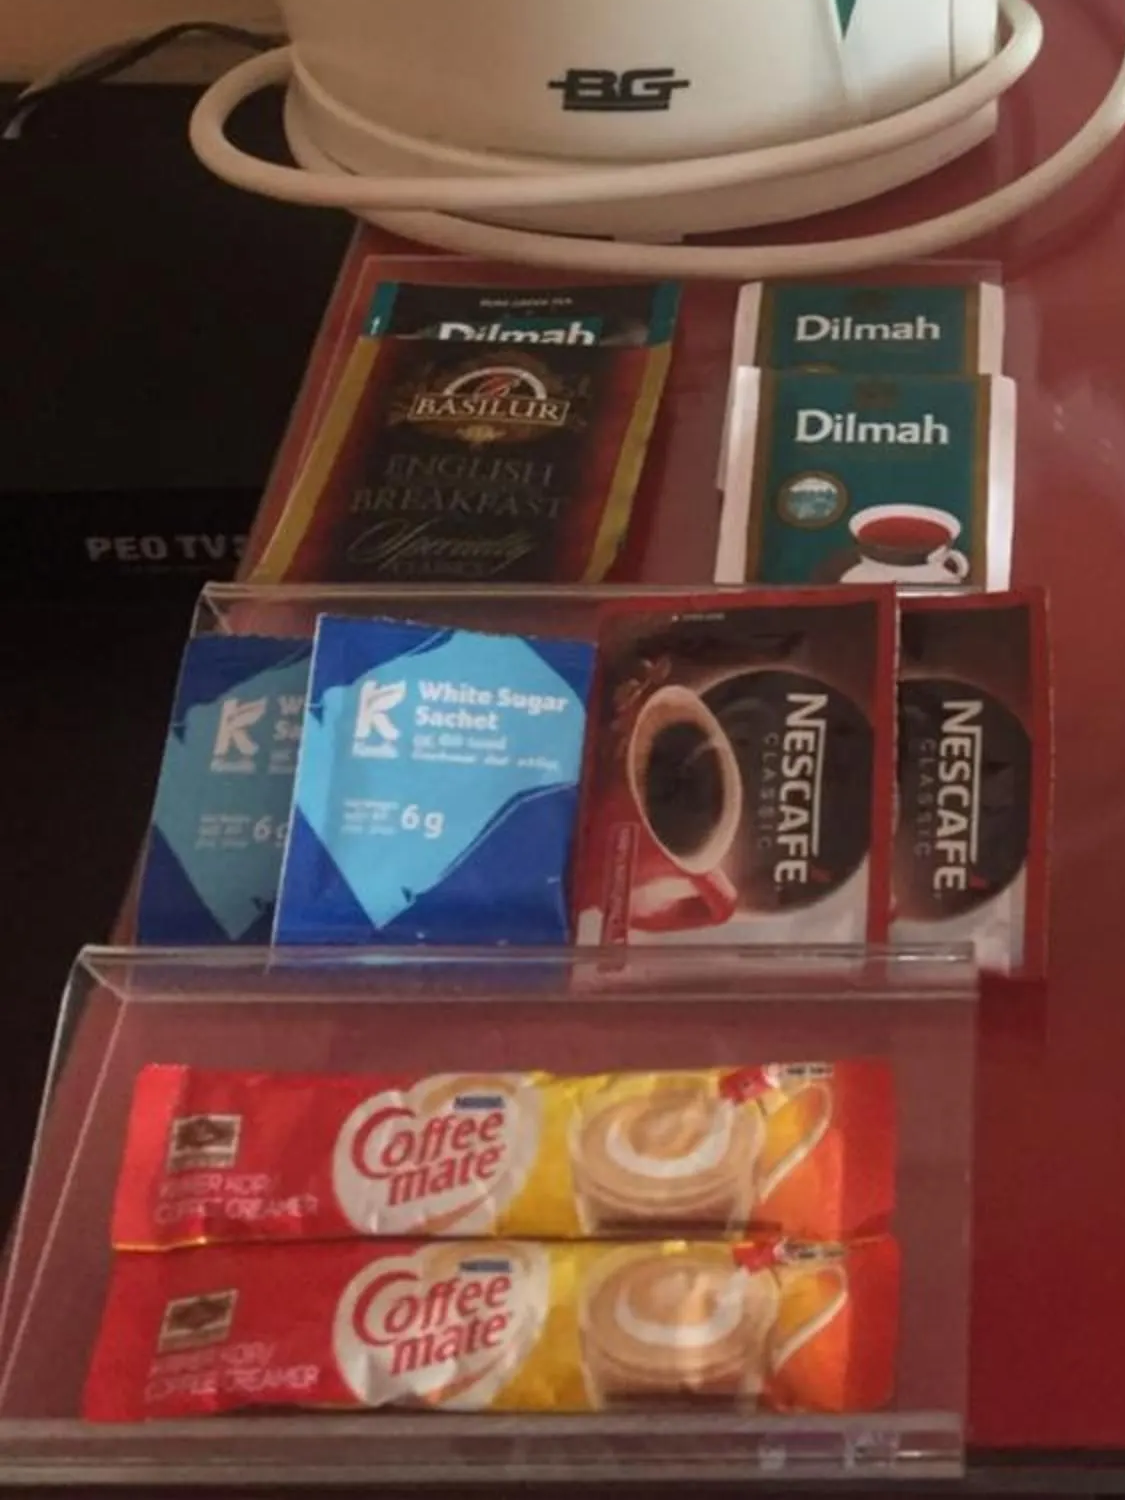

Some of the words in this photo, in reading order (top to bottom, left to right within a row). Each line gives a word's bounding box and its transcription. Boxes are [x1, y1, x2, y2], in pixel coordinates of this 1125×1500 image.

[437, 320, 597, 347] Dilmah
[794, 314, 941, 342] Dilmah
[414, 396, 560, 421] BASILUR
[794, 408, 950, 445] Dilmah
[384, 453, 552, 487] ENGLISH
[348, 486, 567, 519] BREAKFAST
[84, 534, 168, 563] PEO
[174, 533, 226, 561] TV
[418, 678, 493, 706] White
[496, 686, 569, 716] Sugar
[414, 704, 499, 731] Sachet
[758, 731, 780, 849] CLASSIC
[914, 738, 937, 857] CLASSIC
[352, 1106, 505, 1180] Coffee
[387, 1145, 503, 1207] mate
[352, 1269, 513, 1347] Coffee
[390, 1312, 511, 1376] mate
